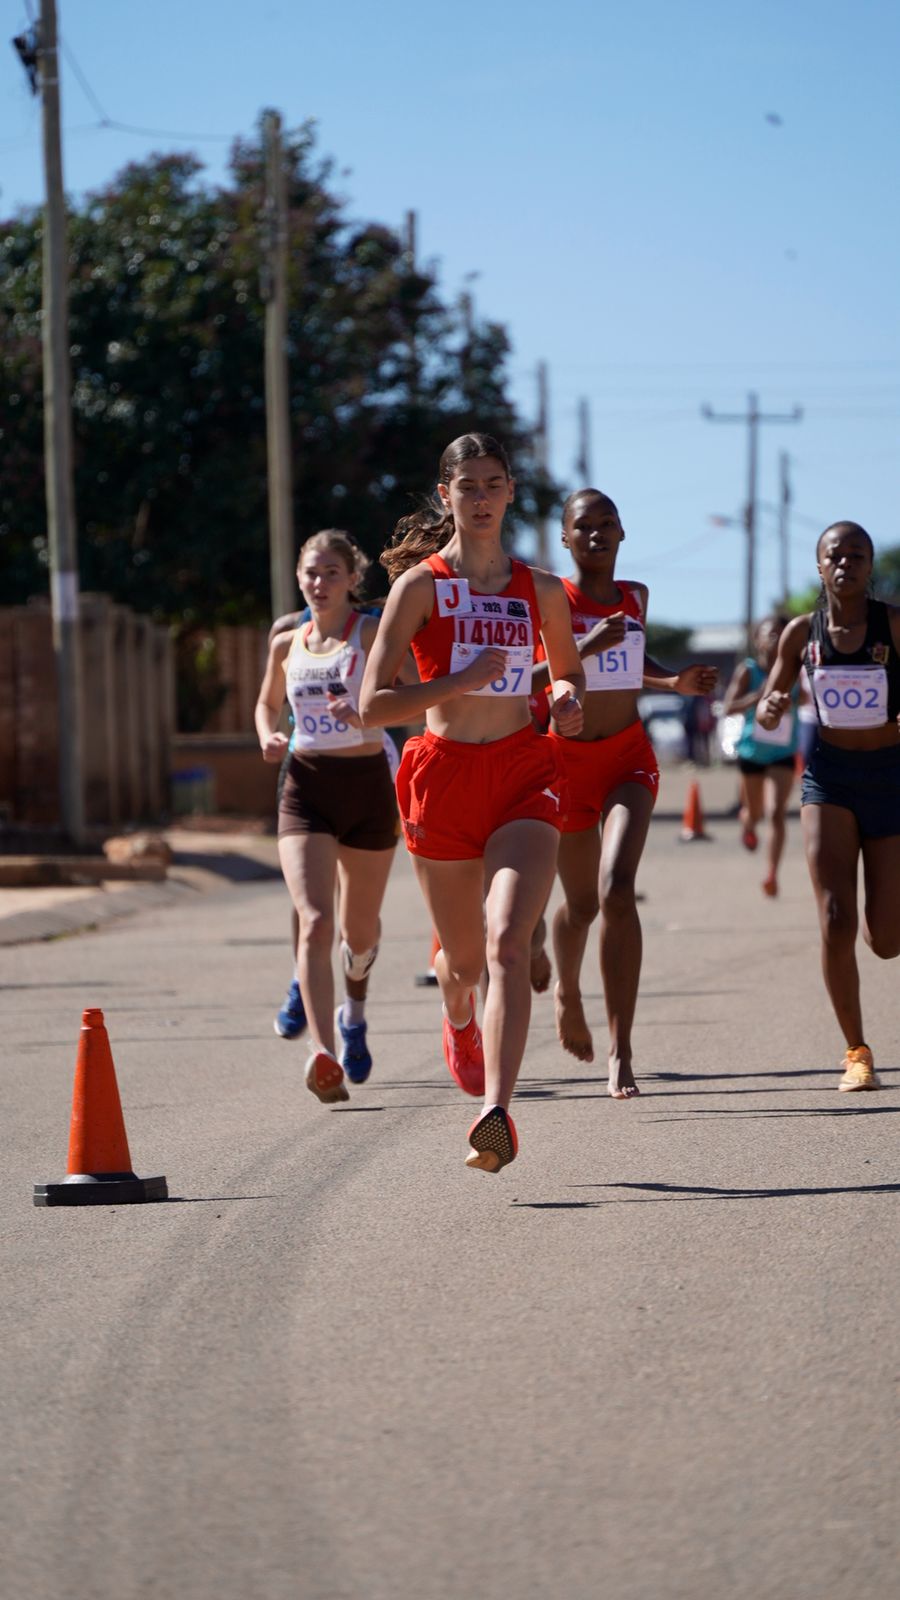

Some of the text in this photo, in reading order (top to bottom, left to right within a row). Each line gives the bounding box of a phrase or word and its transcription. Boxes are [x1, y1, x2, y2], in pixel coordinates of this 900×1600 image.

[445, 584, 459, 608] J
[595, 650, 627, 673] 151
[473, 668, 524, 692] 67
[823, 688, 879, 709] 002
